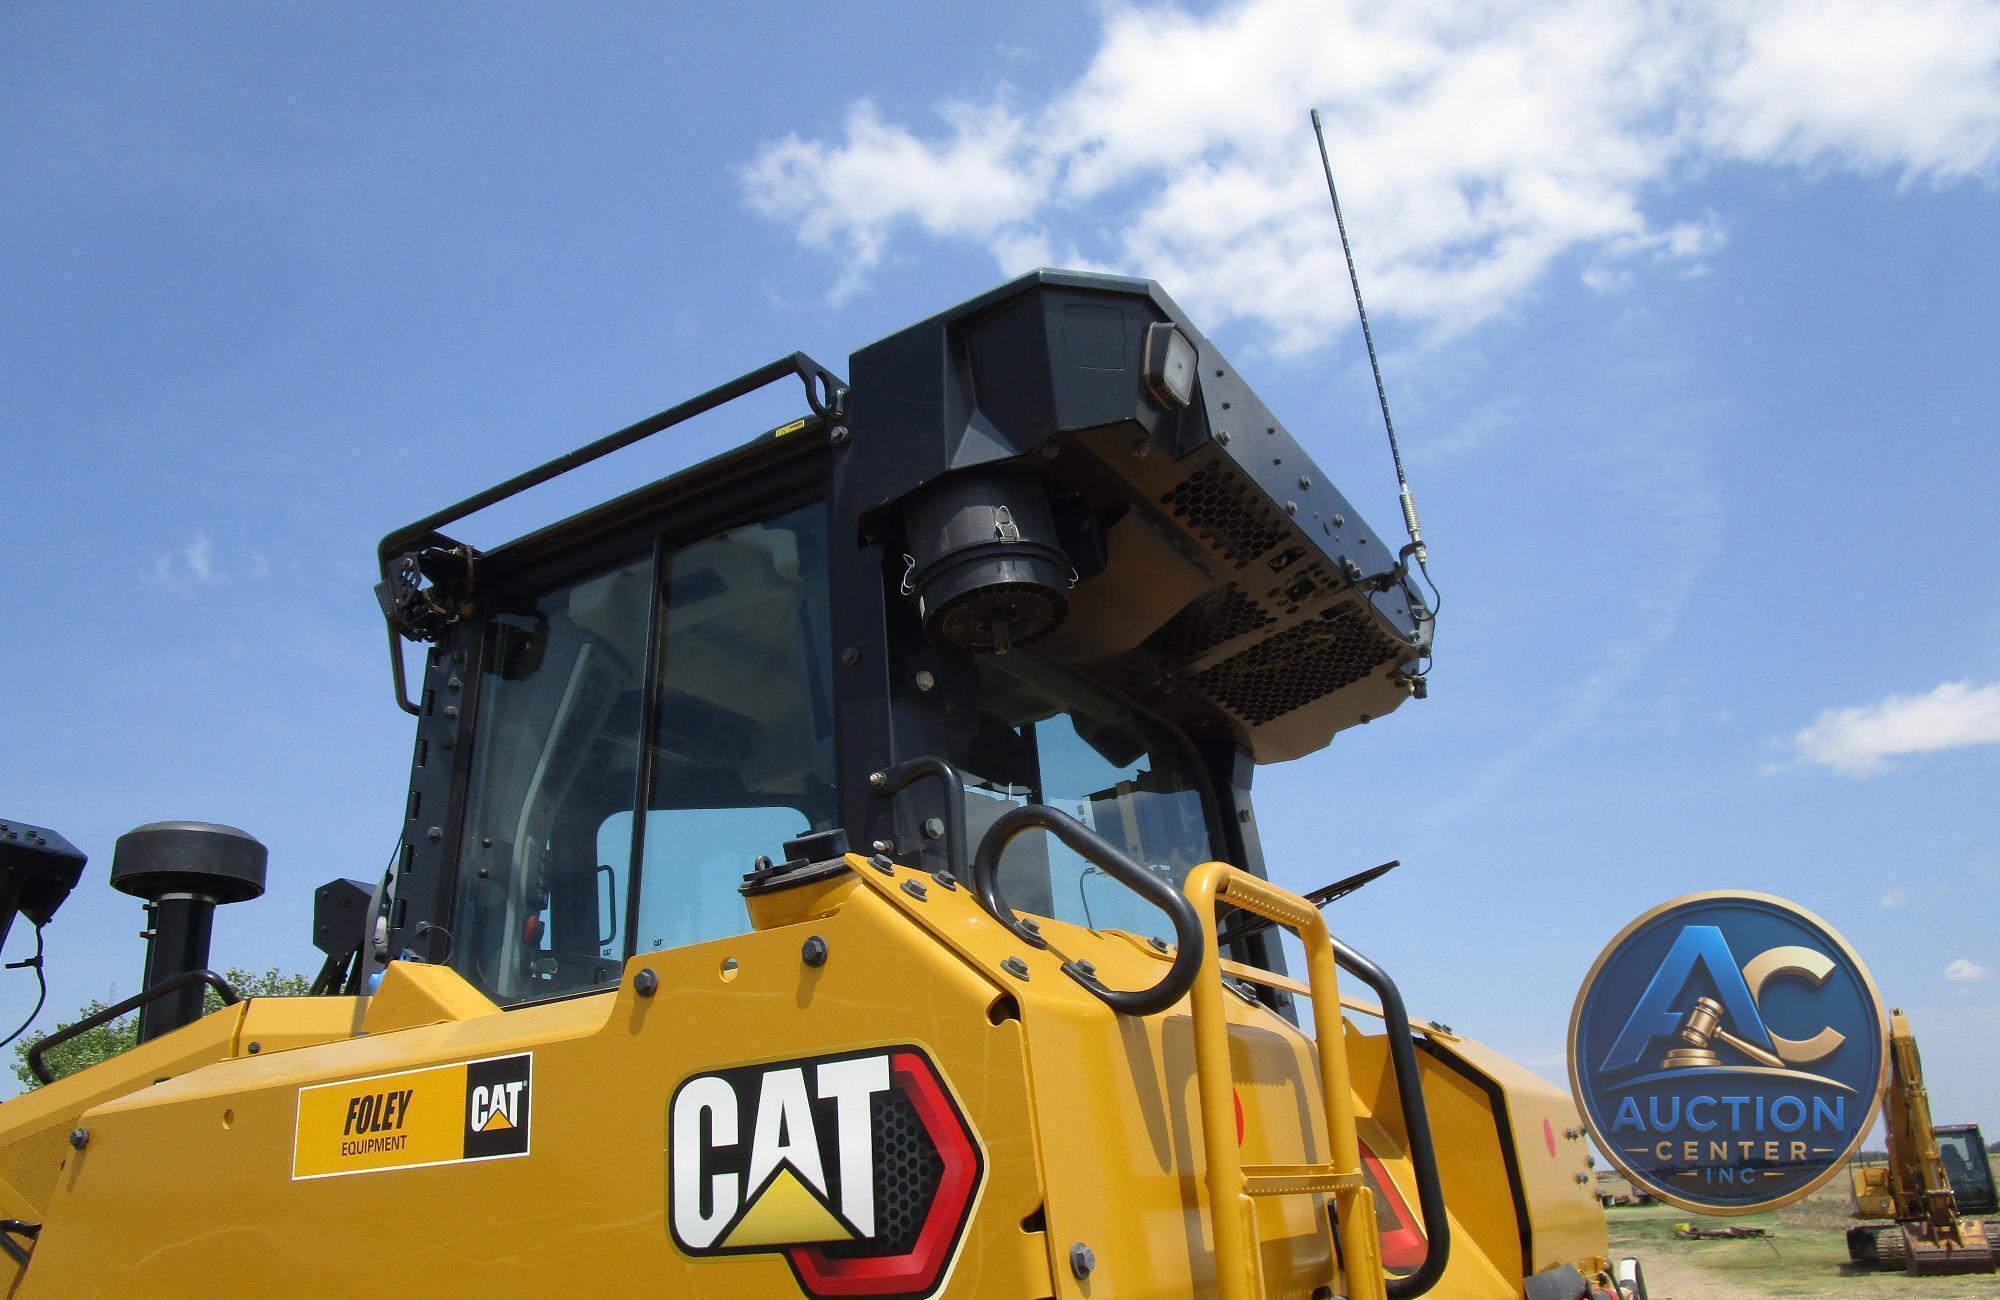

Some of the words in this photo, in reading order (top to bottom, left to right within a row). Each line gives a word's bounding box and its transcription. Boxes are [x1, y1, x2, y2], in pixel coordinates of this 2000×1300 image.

[343, 1088, 414, 1136] FOLEY
[341, 1134, 408, 1156] EQUIPMENT
[673, 1054, 891, 1249] CAT
